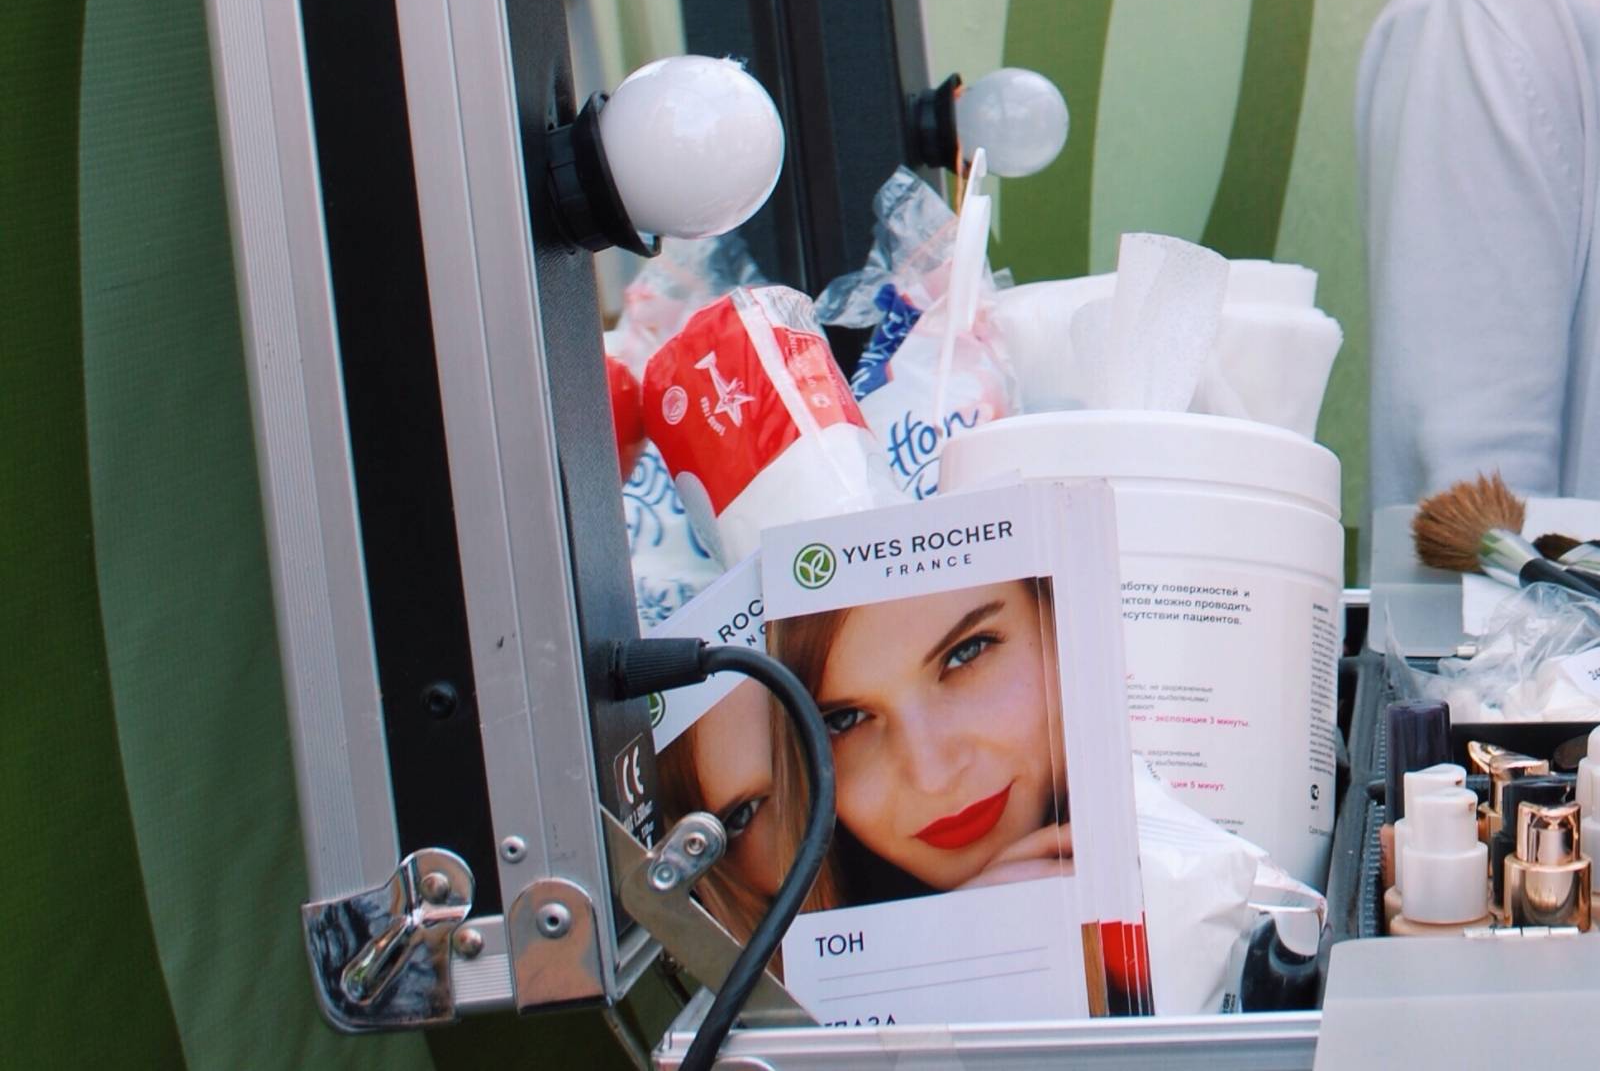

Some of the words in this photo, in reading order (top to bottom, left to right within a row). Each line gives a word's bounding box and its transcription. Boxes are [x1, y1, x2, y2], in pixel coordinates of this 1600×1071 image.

[843, 539, 901, 564] YVES
[912, 520, 1013, 553] ROCHER
[885, 553, 973, 578] FRANCE
[1121, 581, 1158, 594] аботку
[1162, 583, 1239, 597] поверхностей
[1154, 599, 1192, 607] можно
[1195, 599, 1251, 612] проводить
[718, 599, 764, 643] ROC
[1183, 613, 1243, 626] пациентов.
[815, 931, 864, 957] ТОН
